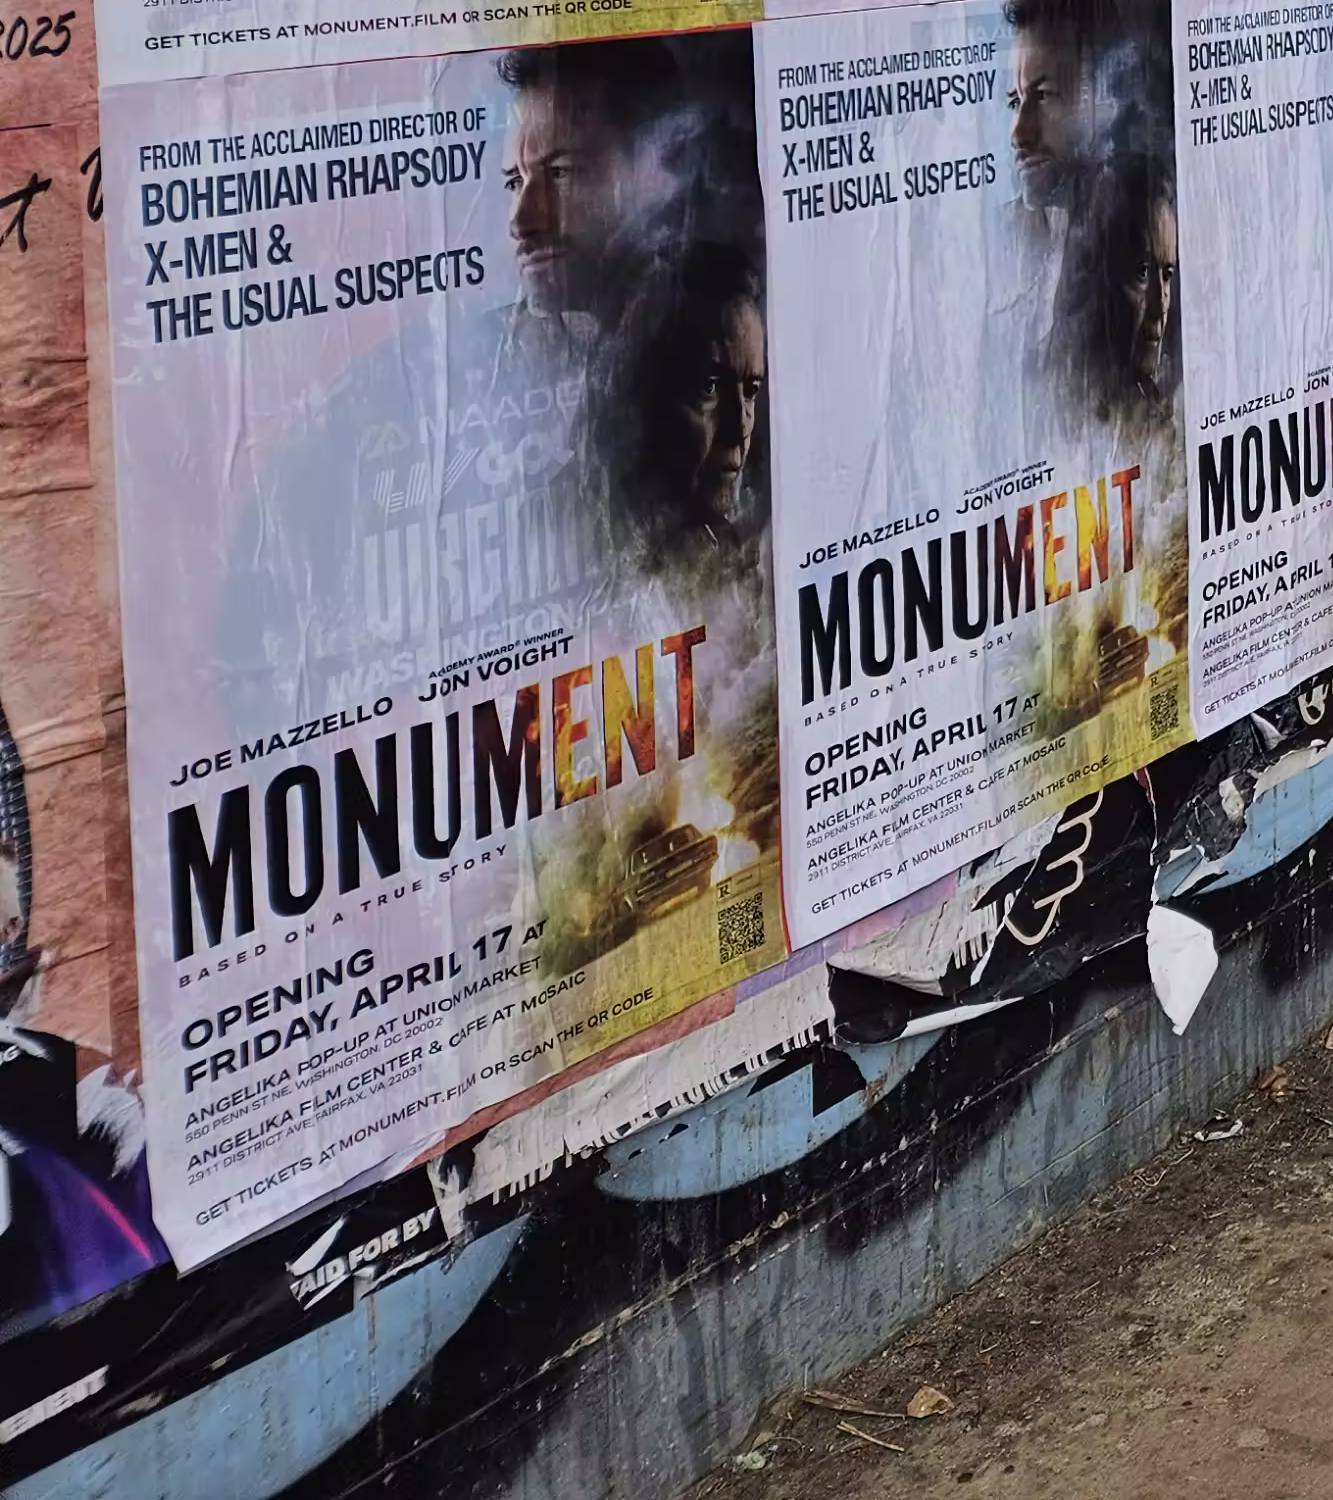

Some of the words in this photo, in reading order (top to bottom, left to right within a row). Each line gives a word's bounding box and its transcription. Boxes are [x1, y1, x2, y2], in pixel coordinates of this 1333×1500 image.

[0, 10, 76, 60] 025
[144, 34, 184, 50] GET
[189, 26, 271, 45] TICKETS
[275, 24, 299, 38] AT
[304, 12, 456, 36] MONUMENT.FILM
[462, 10, 479, 23] OR
[483, 5, 528, 21] SCAN
[531, 2, 561, 16] THE
[564, 0, 587, 15] QR
[141, 163, 317, 226] BOHEMIAN
[326, 141, 484, 199] RHAPSODY
[145, 227, 257, 285] X-MEN
[266, 223, 292, 265] &
[146, 292, 213, 342] THE
[222, 274, 327, 330] USUAL
[335, 246, 484, 308] SUSPECTS
[800, 540, 839, 570] JOE
[842, 508, 940, 557] MAZZELLO
[798, 464, 1142, 706] MONUMENT
[417, 669, 469, 702] JON
[476, 635, 573, 681] VOIGHT
[169, 749, 232, 786] JOE
[240, 696, 392, 762] MAZZELLO
[804, 706, 928, 778] OPENING
[167, 625, 706, 962] MONUMENT
[182, 950, 374, 1049] OPENING
[184, 1001, 342, 1094] FRIDAY,
[349, 951, 461, 1020] APRIL
[472, 925, 513, 961] 17
[522, 919, 547, 945] AT
[291, 1262, 341, 1300] AID
[348, 1233, 398, 1270] FOR
[402, 1205, 438, 1243] BY
